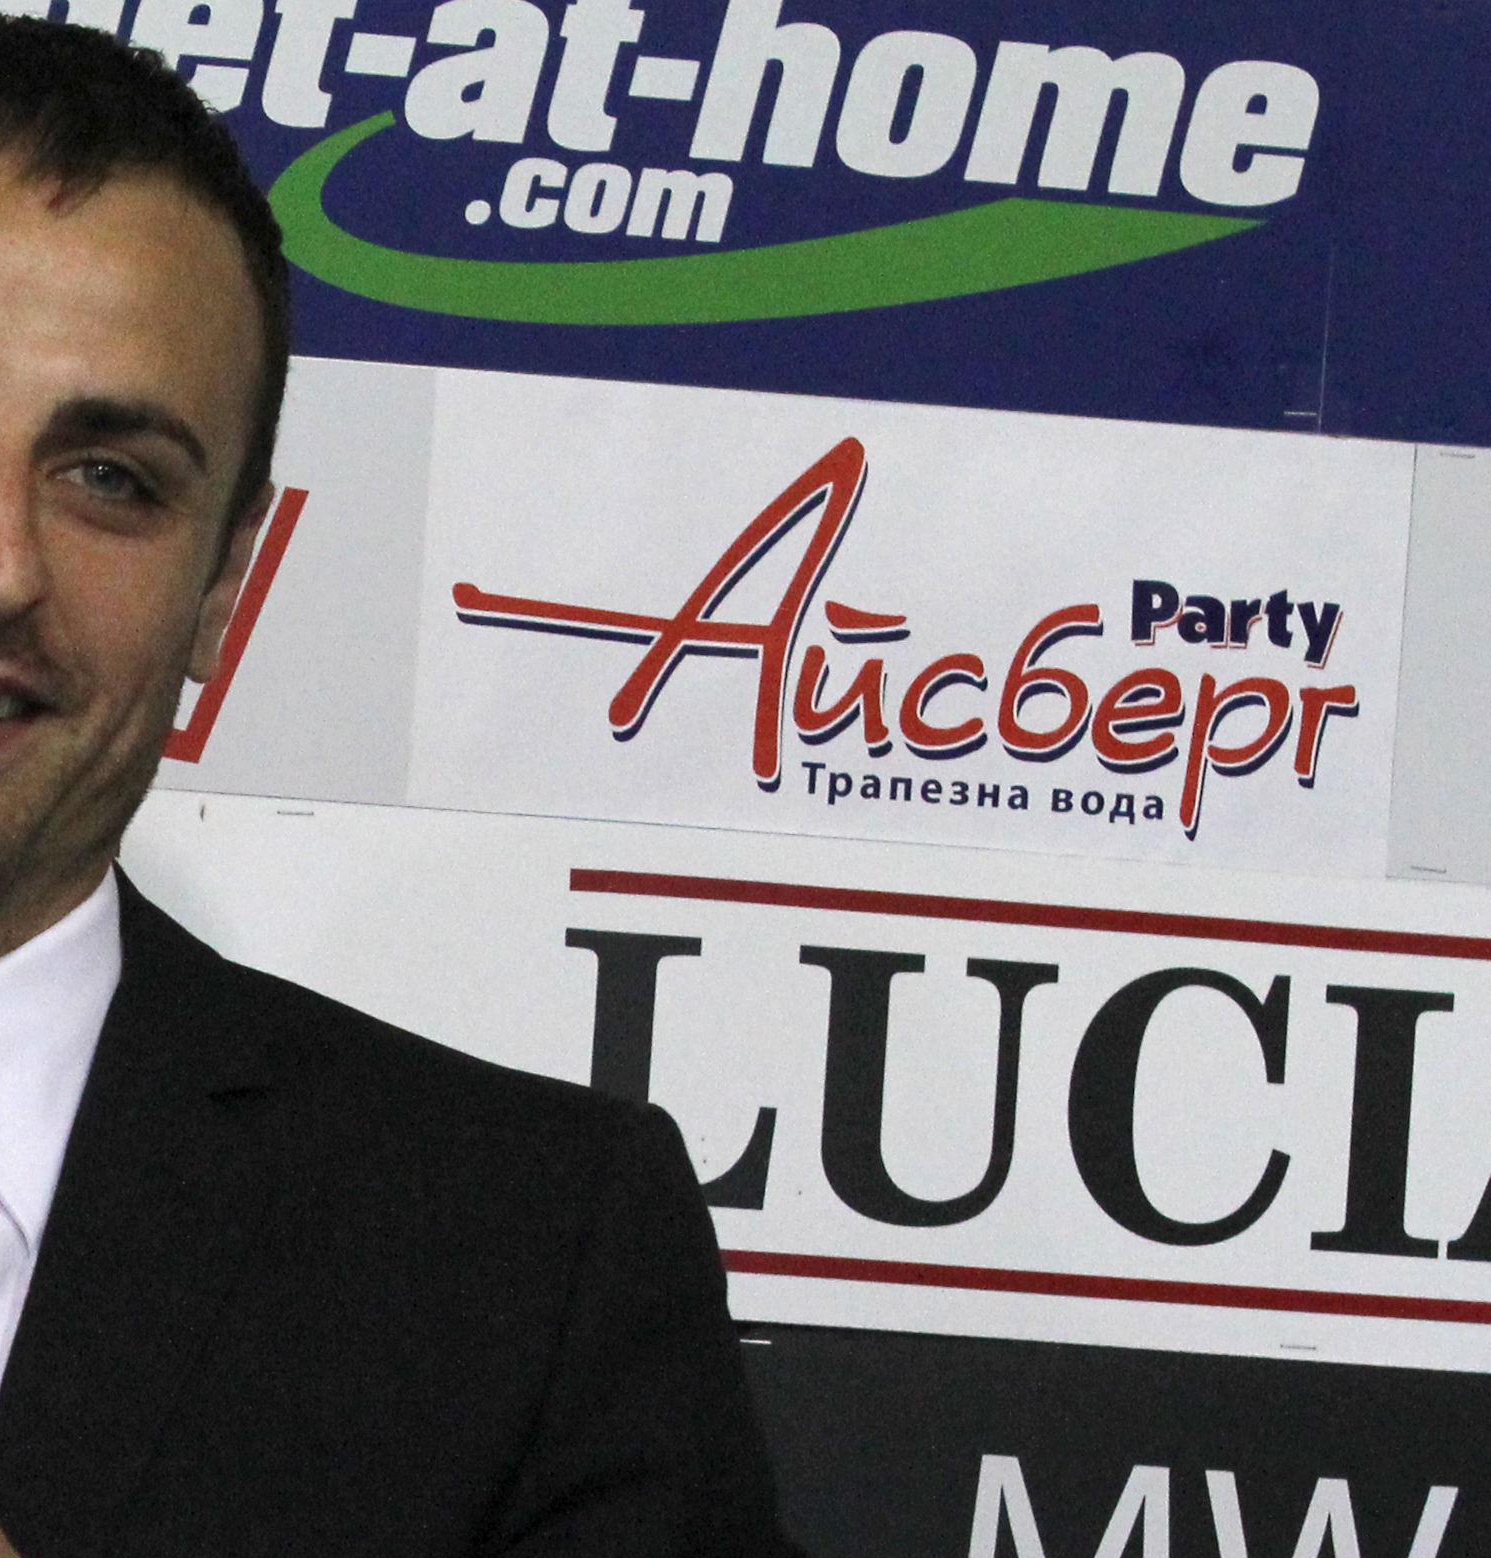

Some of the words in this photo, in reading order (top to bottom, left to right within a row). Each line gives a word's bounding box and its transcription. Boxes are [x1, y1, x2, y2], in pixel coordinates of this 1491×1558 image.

[465, 157, 733, 242] .com
[452, 436, 1359, 838] Айсберг
[1129, 580, 1343, 668] Party
[801, 761, 1030, 811] Трапезна
[1050, 786, 1165, 825] вода
[564, 927, 1491, 1264] LUCI
